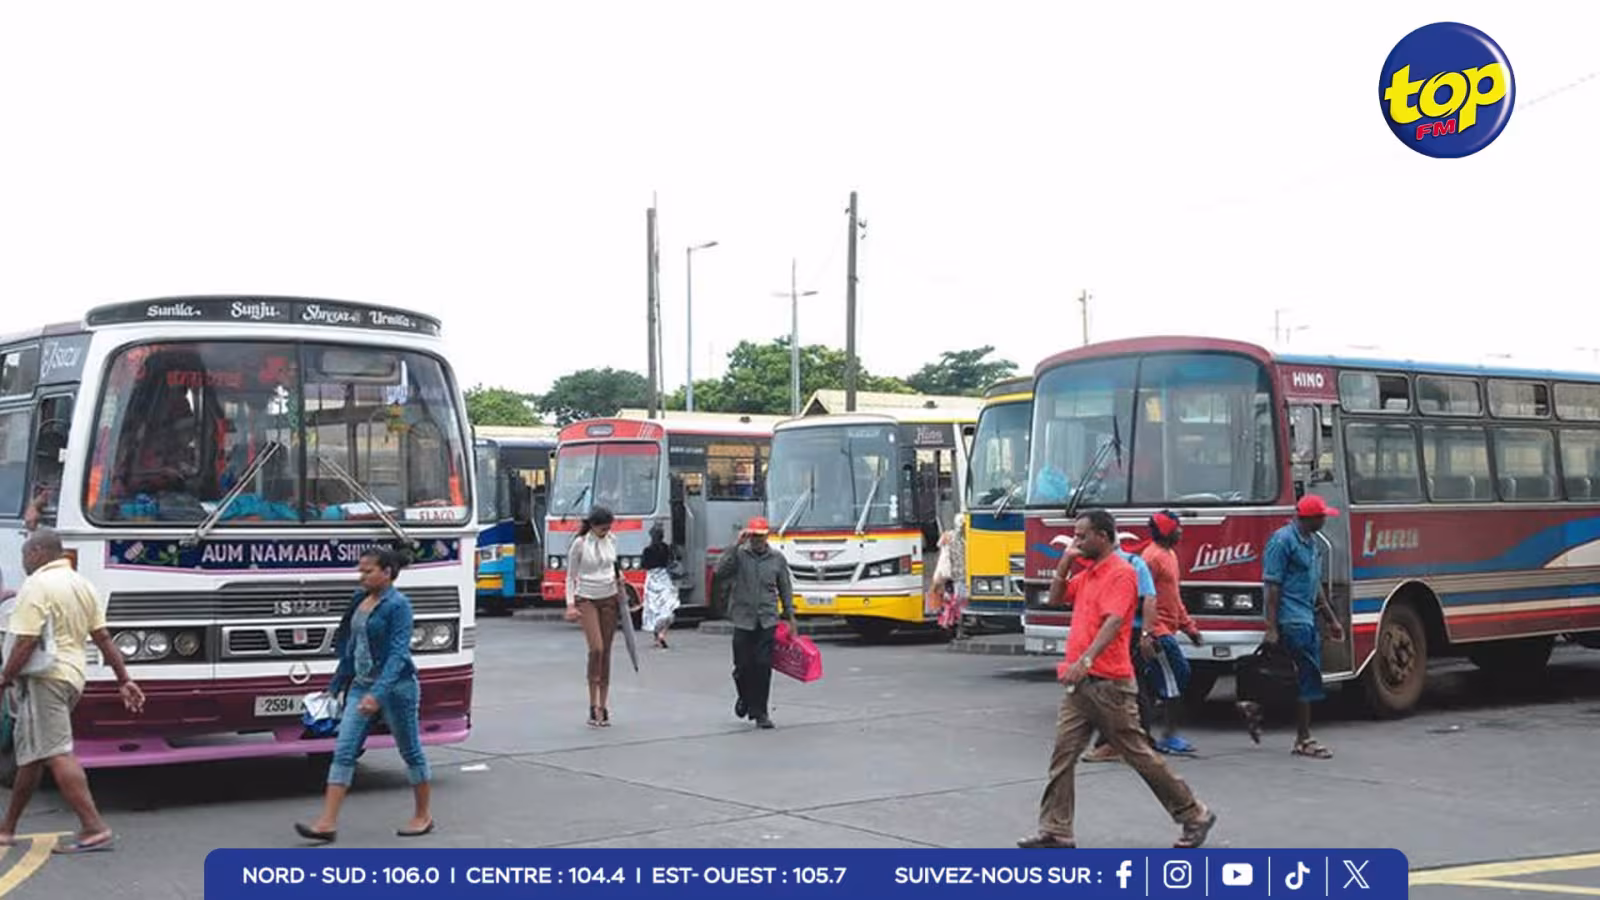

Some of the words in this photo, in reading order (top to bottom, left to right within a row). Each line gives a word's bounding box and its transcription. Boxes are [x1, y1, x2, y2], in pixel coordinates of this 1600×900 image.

[1292, 371, 1325, 388] HINO
[201, 543, 243, 562] AUM
[249, 542, 332, 562] NAMAHA
[273, 600, 331, 614] ISUZU
